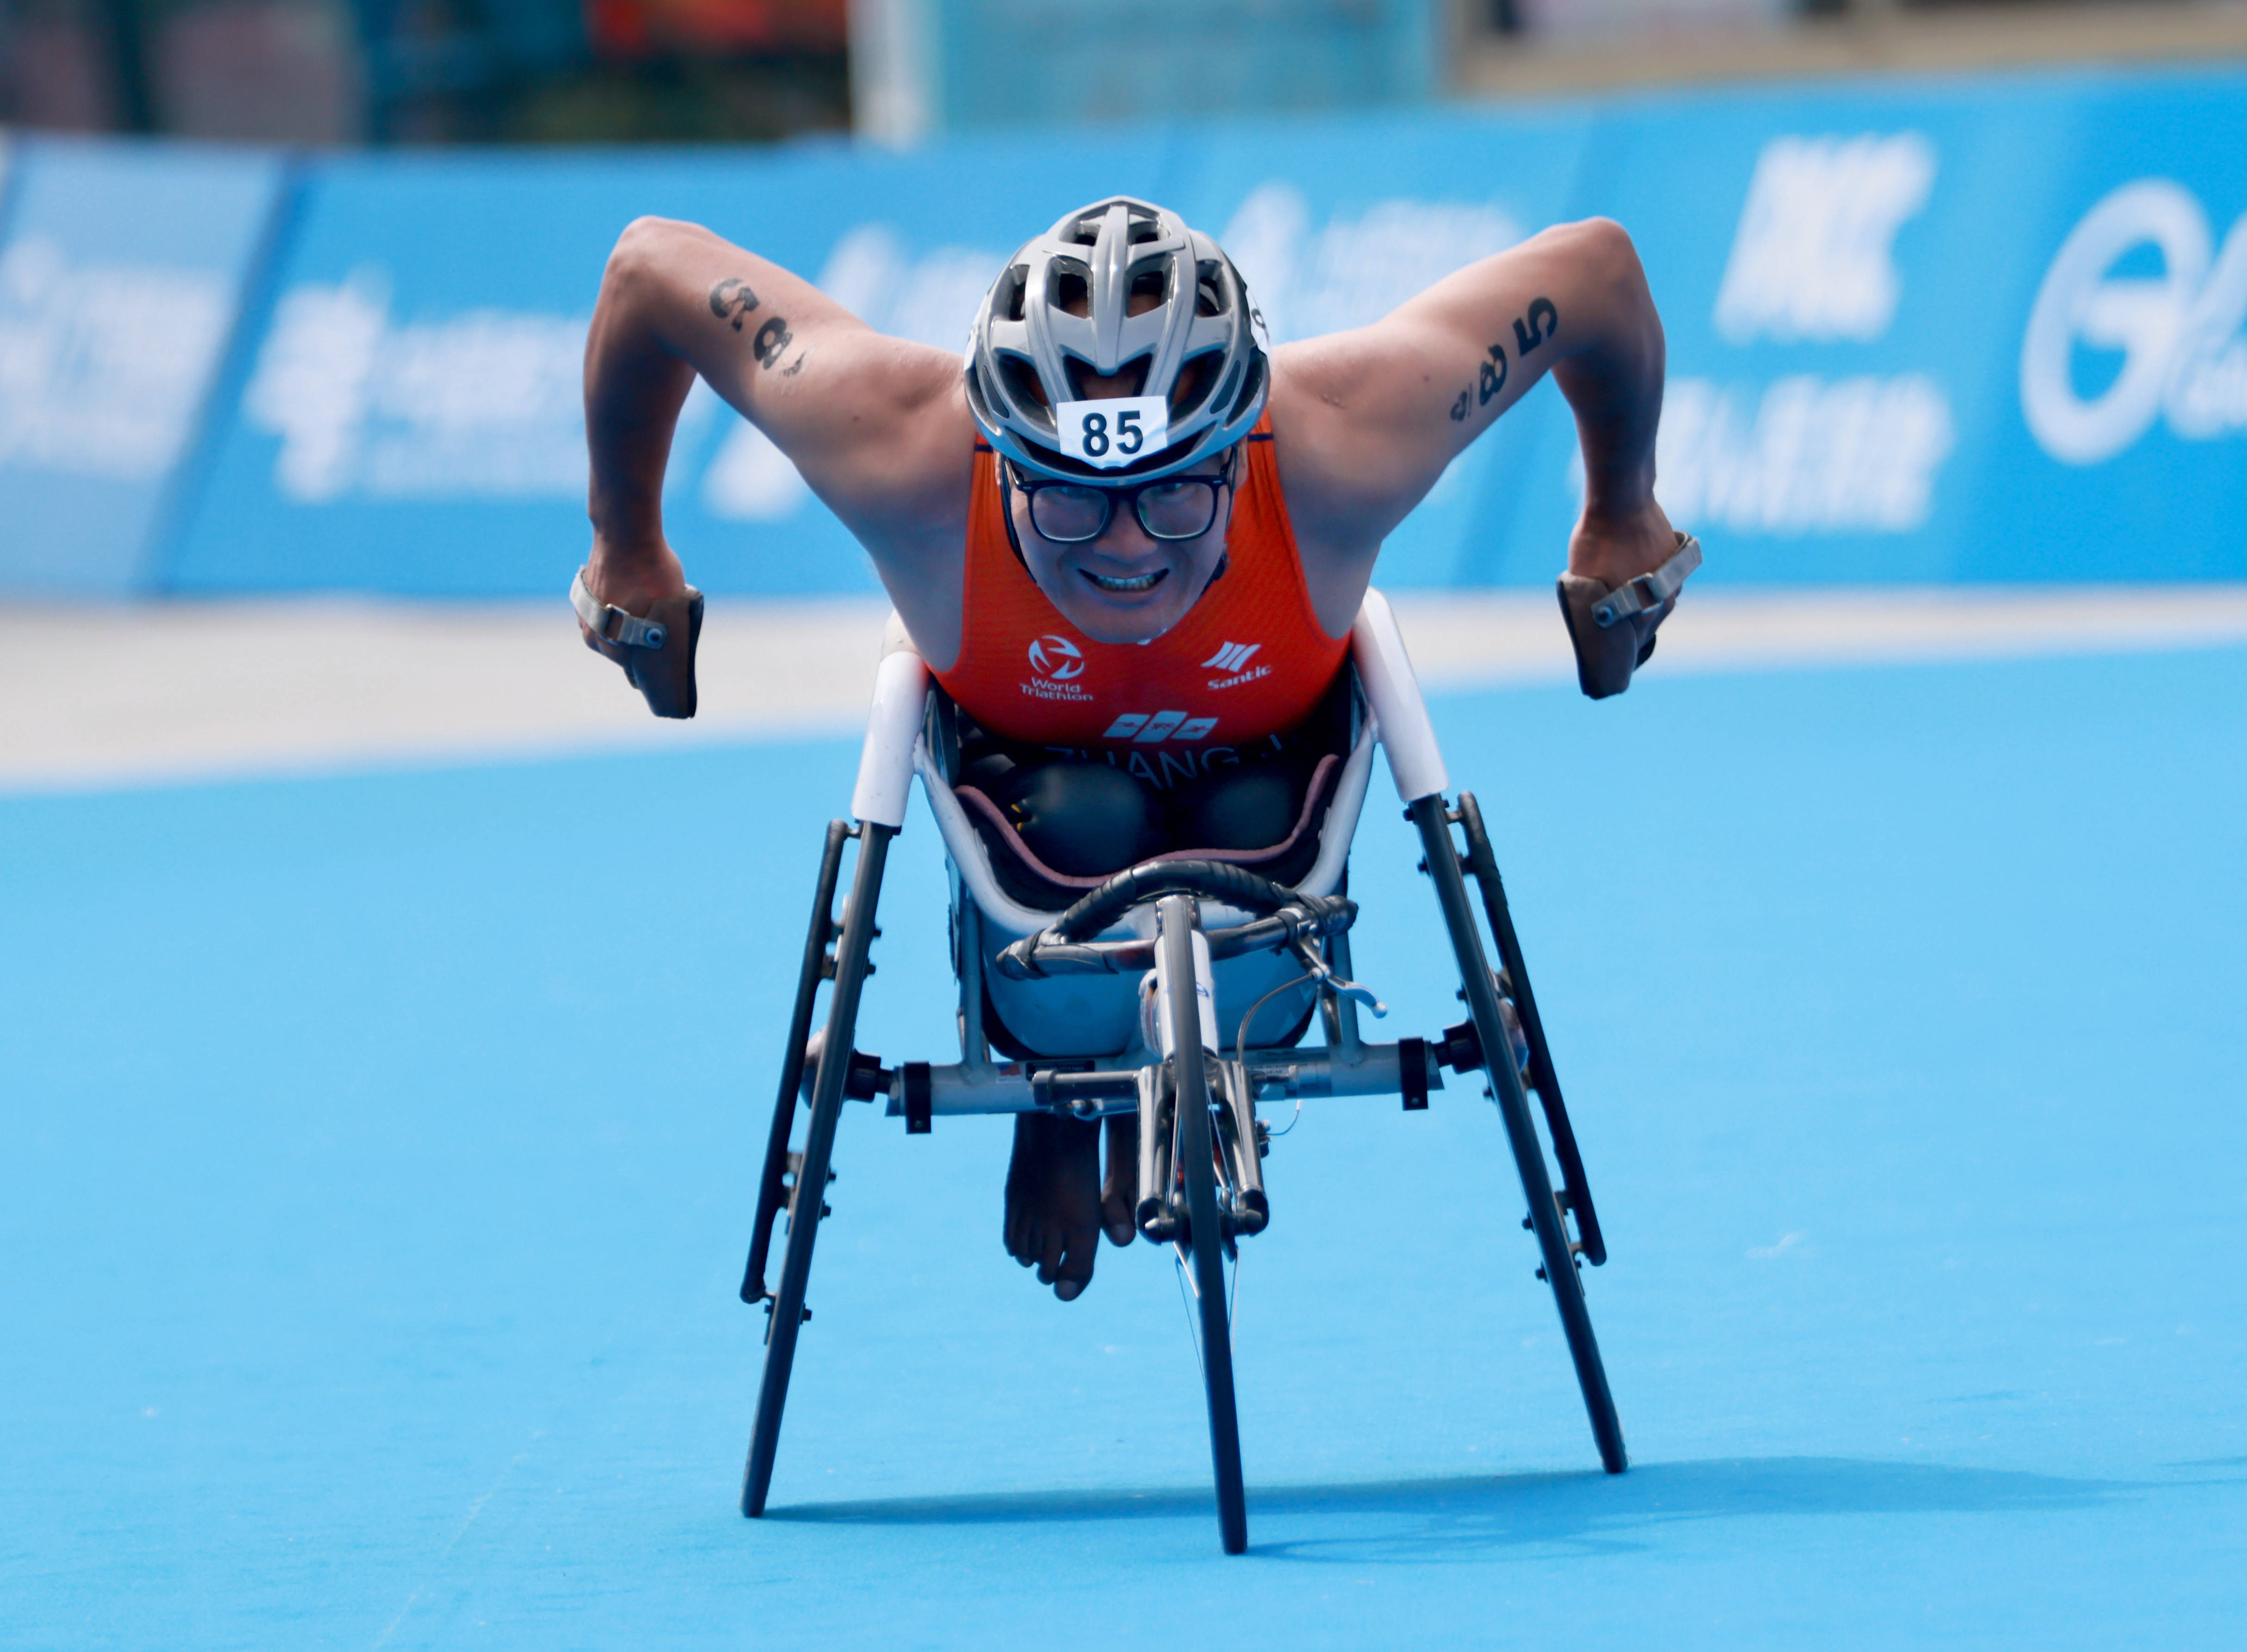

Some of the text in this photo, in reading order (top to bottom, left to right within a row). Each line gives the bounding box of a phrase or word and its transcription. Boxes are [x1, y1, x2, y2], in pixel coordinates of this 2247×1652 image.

[1479, 296, 1558, 407] 85
[1082, 410, 1143, 457] 85
[1019, 683, 1094, 701] Triathlon
[1031, 677, 1081, 693] World
[1207, 664, 1272, 690] Santic
[1044, 746, 1240, 790] ANG
